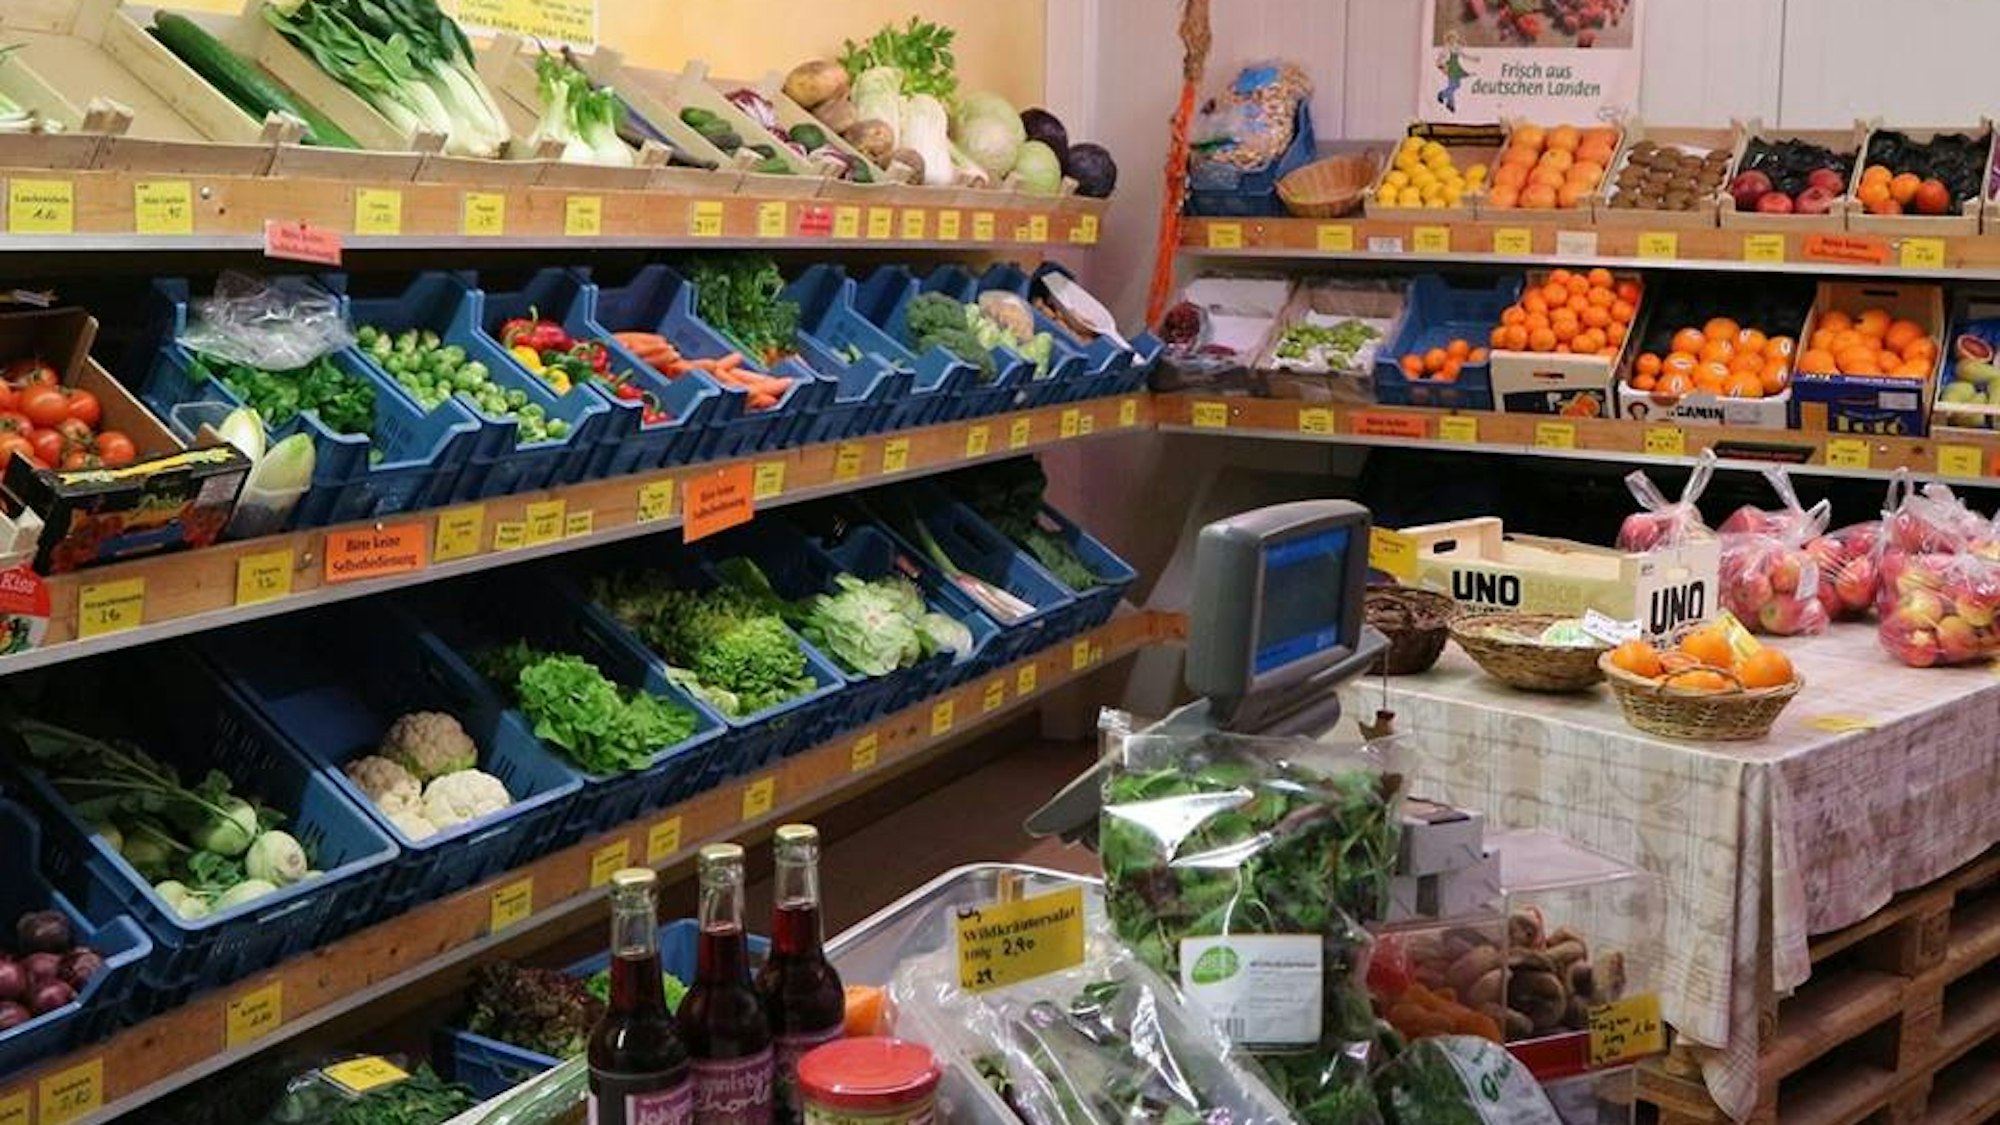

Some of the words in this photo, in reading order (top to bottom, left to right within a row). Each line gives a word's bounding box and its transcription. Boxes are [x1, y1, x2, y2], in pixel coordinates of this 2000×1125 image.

[1501, 61, 1541, 79] Frisch
[1545, 65, 1572, 79] aus
[1471, 79, 1543, 95] deutschen
[1547, 79, 1600, 97] Landen
[346, 538, 371, 552] Bitte
[373, 535, 401, 549] keine
[333, 552, 418, 574] Selbstbedienung
[1453, 570, 1520, 607] UNO
[1650, 580, 1706, 636] UNO
[963, 906, 1076, 942] Wildkräutersalat
